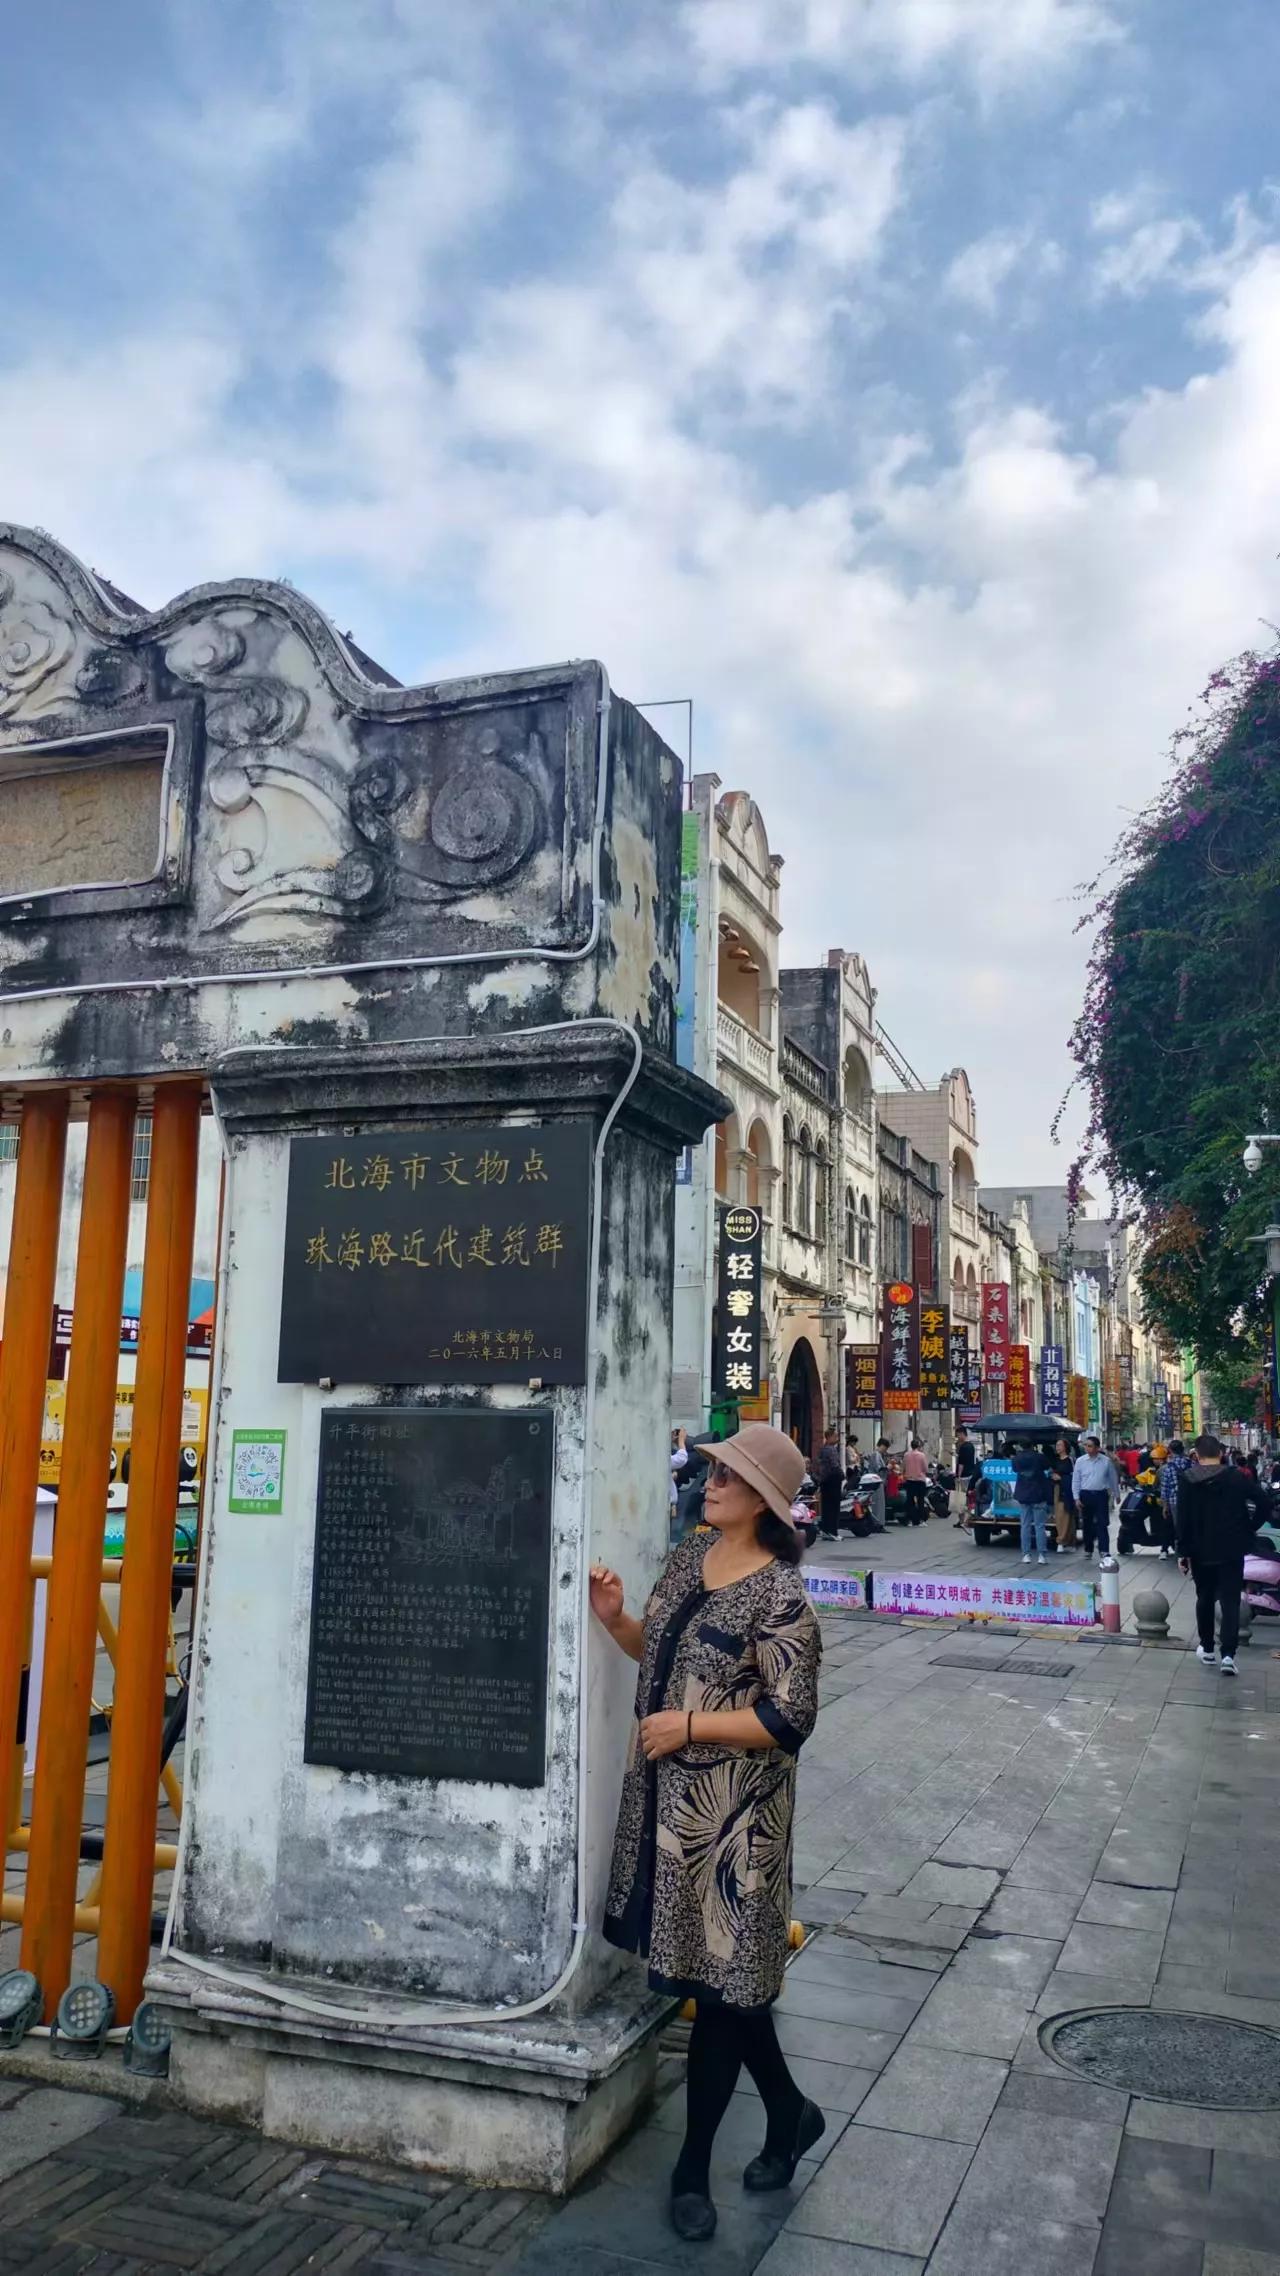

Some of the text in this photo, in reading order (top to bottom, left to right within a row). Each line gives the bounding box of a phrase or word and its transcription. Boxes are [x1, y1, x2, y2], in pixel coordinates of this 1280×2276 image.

[324, 1147, 549, 1191] 北海市文物点
[726, 1216, 753, 1225] MISS
[726, 1226, 753, 1234] SHAN
[304, 1222, 564, 1271] 珠海路近代建筑群
[452, 1328, 535, 1345] 北海市文物局
[726, 1252, 754, 1391] 轻奢女装
[920, 1310, 945, 1360] 李姨
[890, 1306, 911, 1389] 海鲜菜馆
[950, 1336, 968, 1403] 越南鞋城
[855, 1358, 877, 1408] 烟酒店
[891, 1582, 982, 1603] 创建全国文明城市
